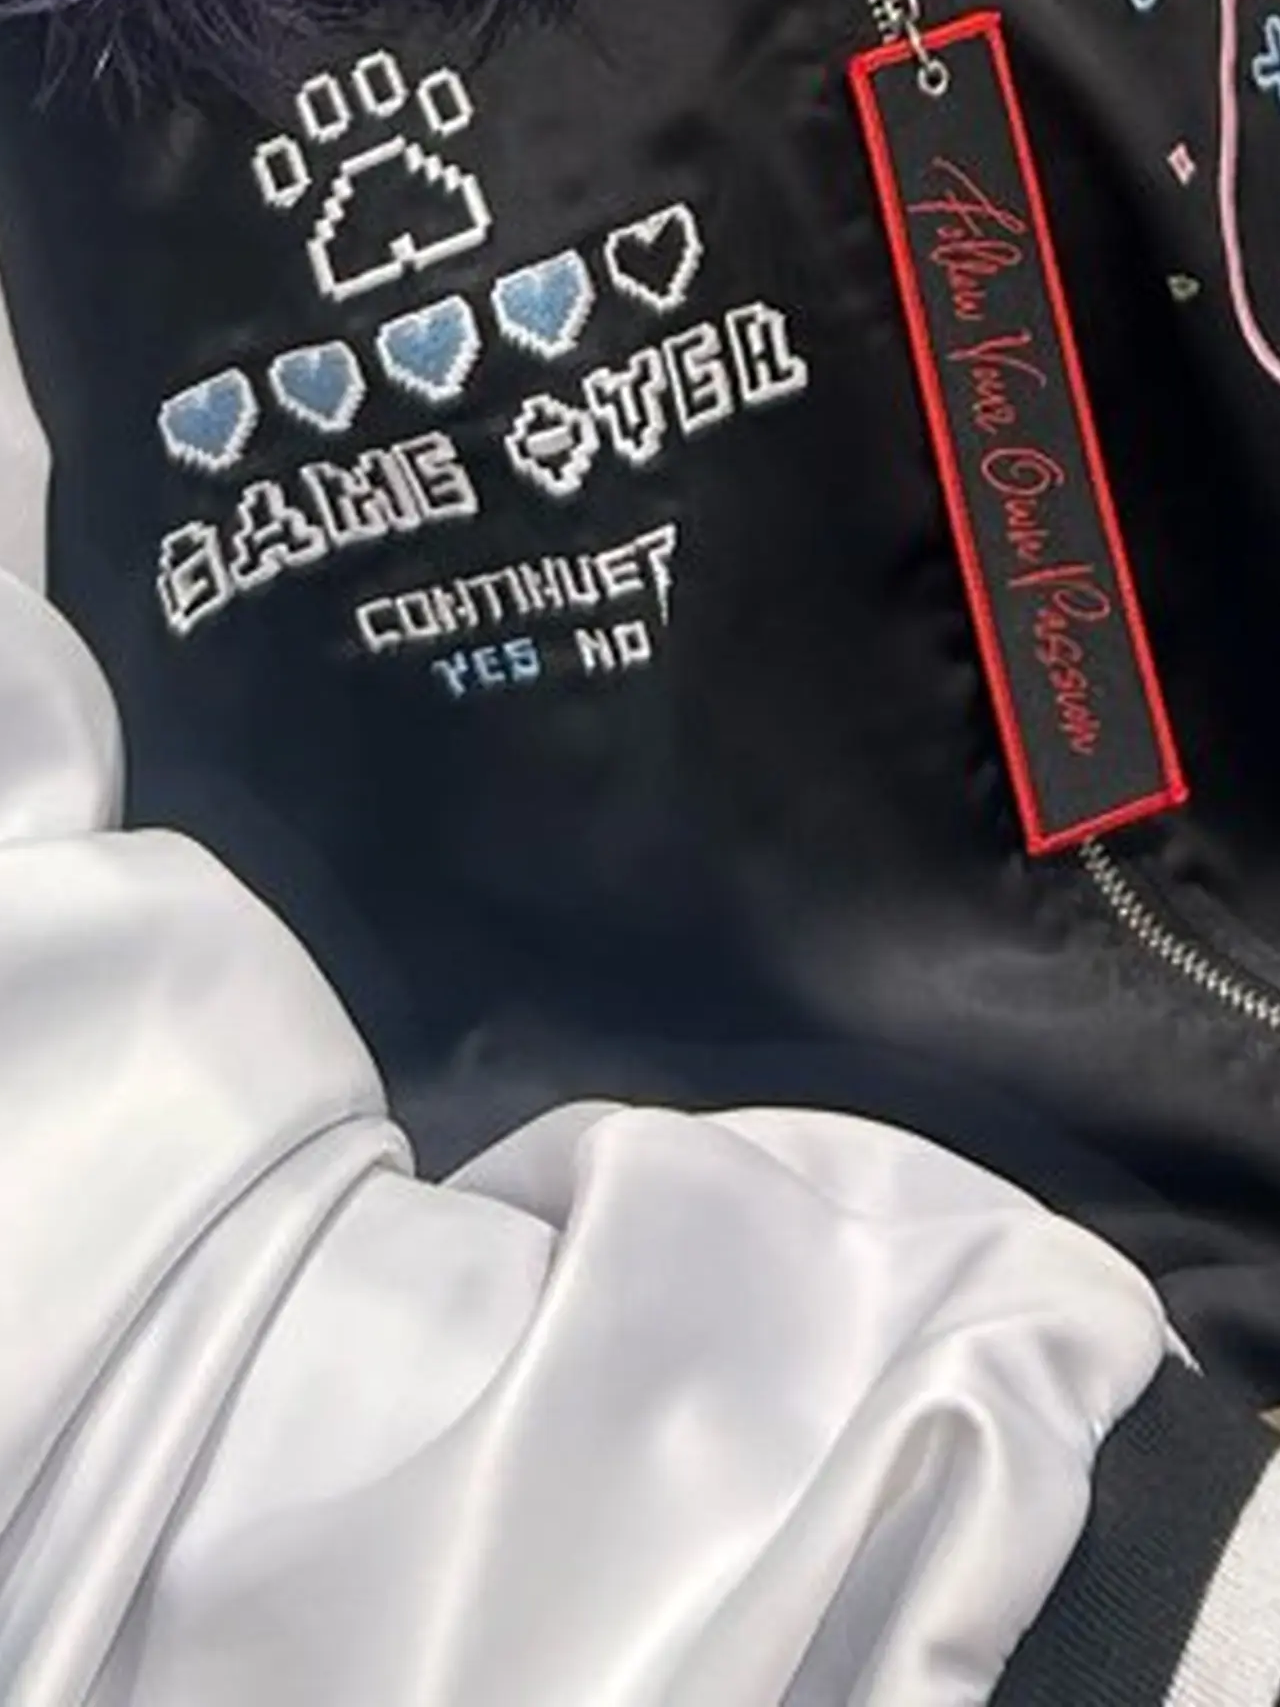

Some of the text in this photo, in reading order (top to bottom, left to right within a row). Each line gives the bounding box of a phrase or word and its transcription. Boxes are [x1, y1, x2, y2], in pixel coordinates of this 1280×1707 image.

[946, 328, 1047, 436] Your
[157, 300, 809, 633] GAME OVER
[980, 447, 1065, 565] Own
[430, 619, 652, 699] YES NO
[1007, 562, 1111, 756] Passion
